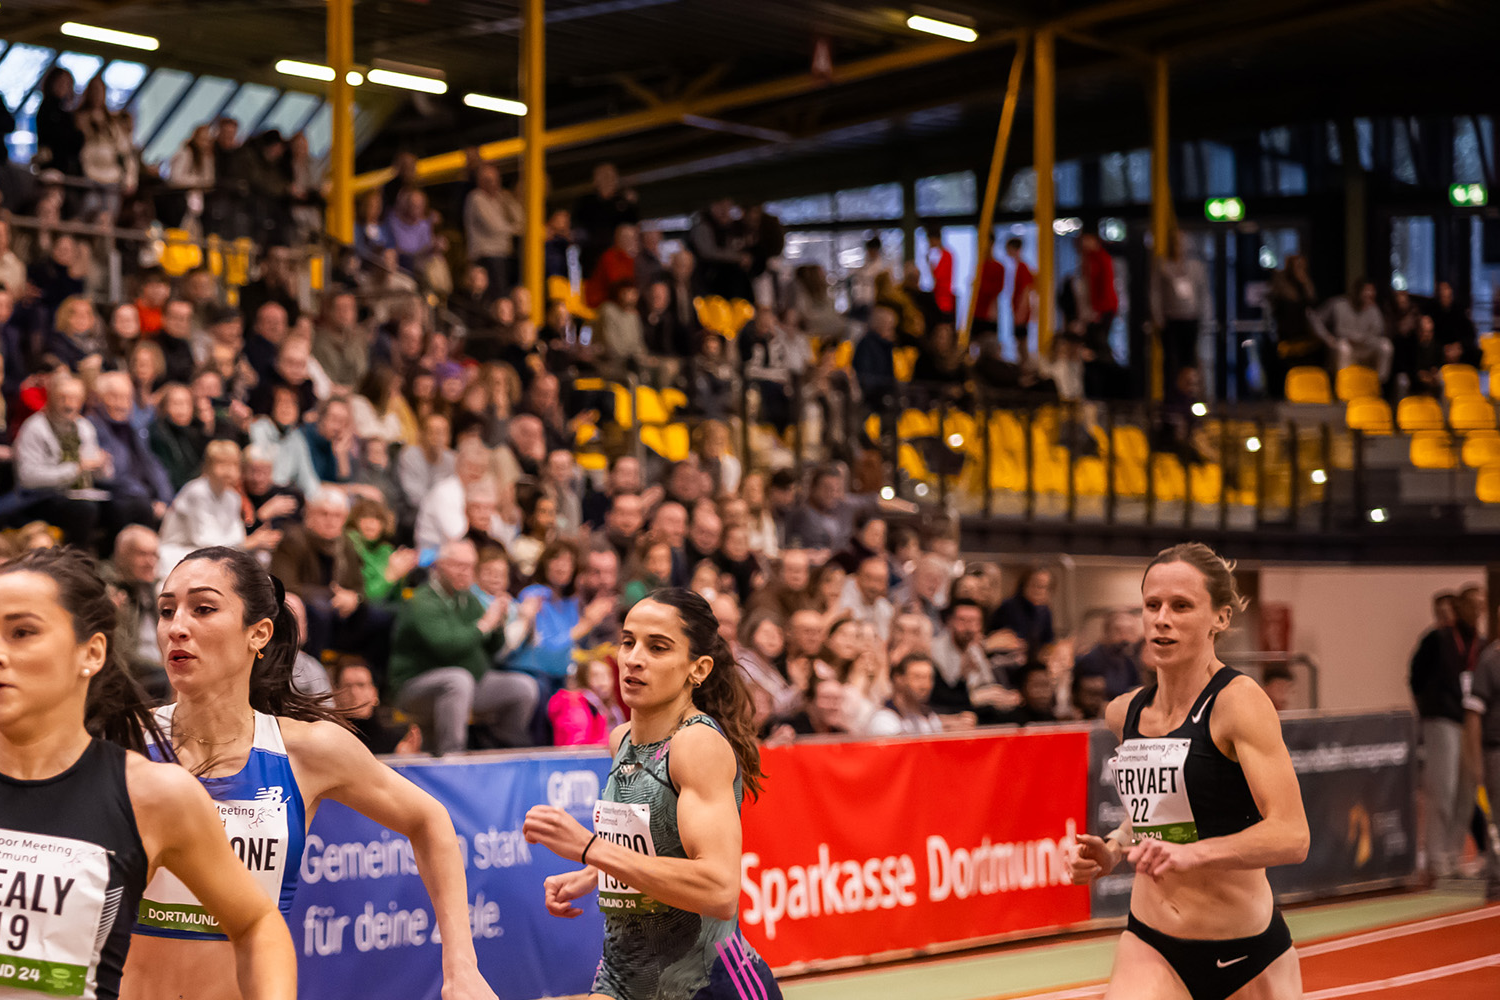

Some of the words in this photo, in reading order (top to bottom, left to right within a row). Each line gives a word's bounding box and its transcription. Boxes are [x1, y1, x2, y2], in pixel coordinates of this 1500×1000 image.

[1131, 798, 1149, 823] 22
[22, 839, 72, 857] Meeting
[740, 842, 917, 940] Sparkasse
[926, 817, 1077, 901] Dortmund
[303, 904, 351, 957] für
[353, 899, 429, 953] deine
[18, 967, 41, 982] 24
